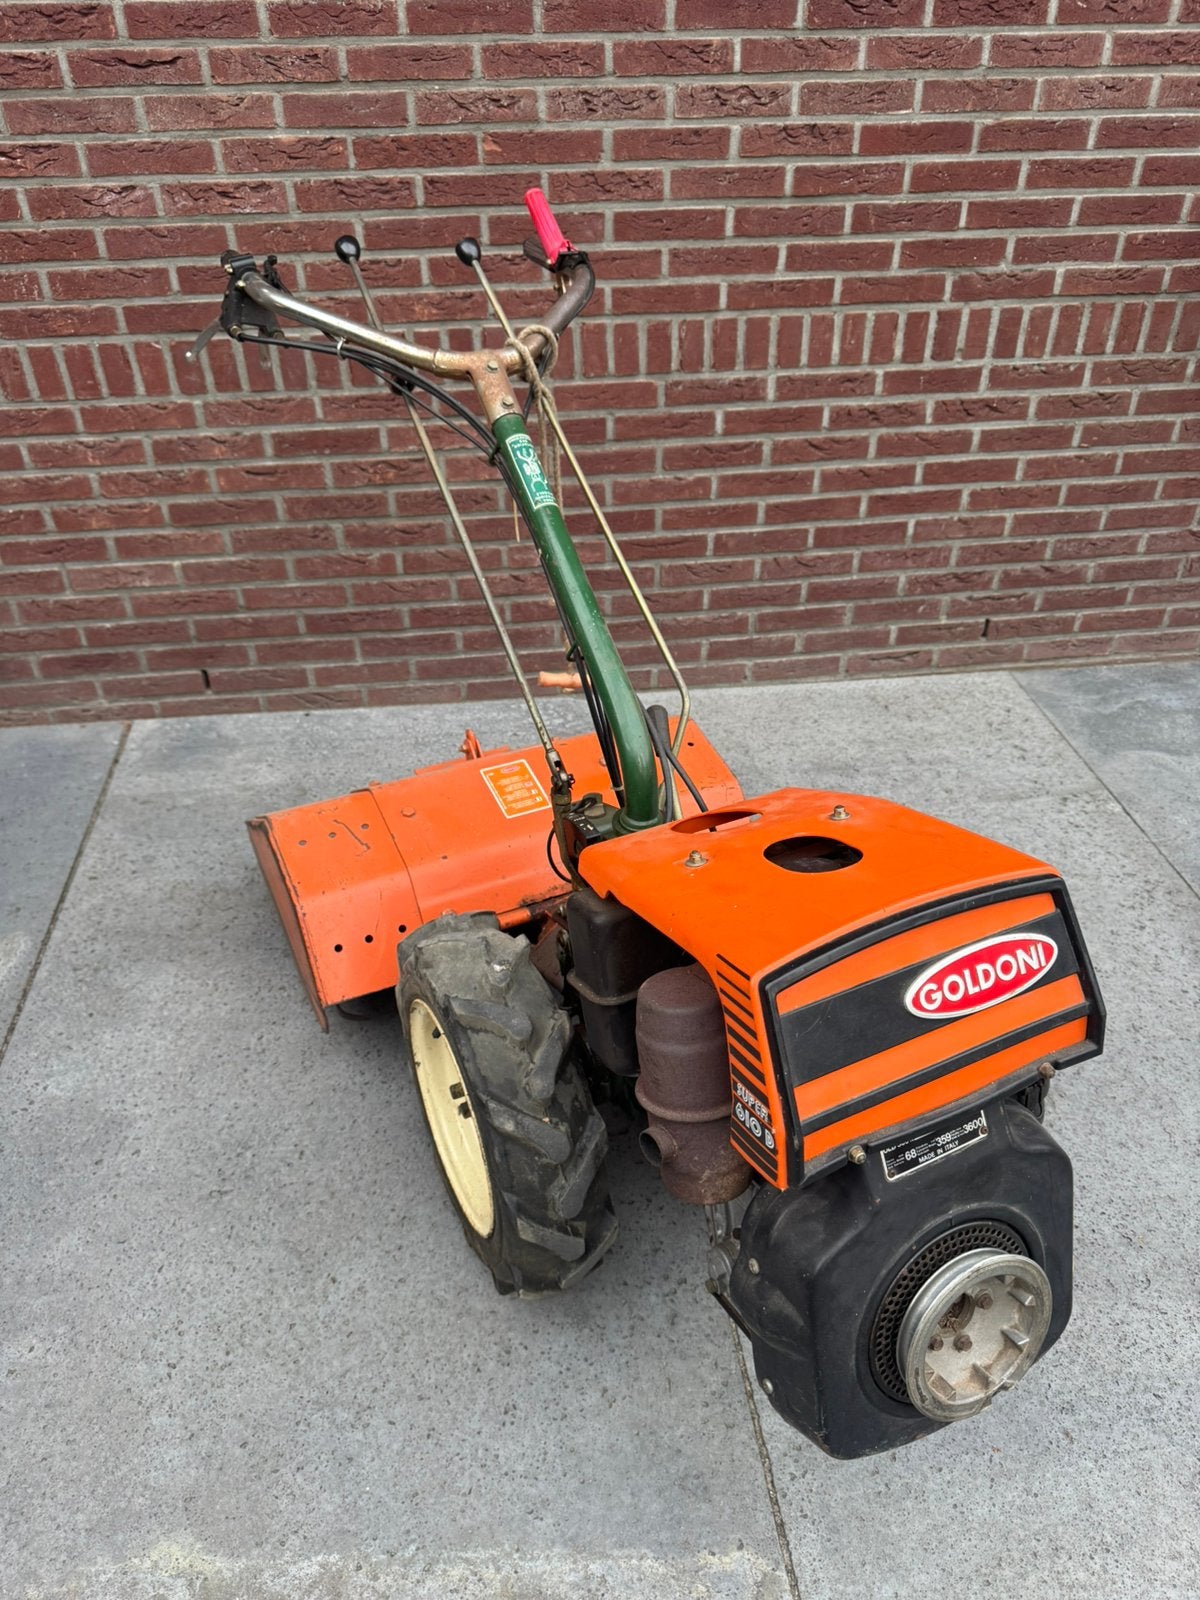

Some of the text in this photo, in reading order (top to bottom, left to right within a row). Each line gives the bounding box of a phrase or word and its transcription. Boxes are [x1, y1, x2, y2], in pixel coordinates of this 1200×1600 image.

[919, 943, 1047, 1010] GOLDONI
[736, 1082, 768, 1122] SUPER
[736, 1103, 774, 1149] 610 D
[905, 1148, 917, 1160] 68
[936, 1132, 952, 1147] 359
[963, 1117, 983, 1134] 3600
[918, 1153, 935, 1163] MADE
[944, 1140, 959, 1152] ITALY
